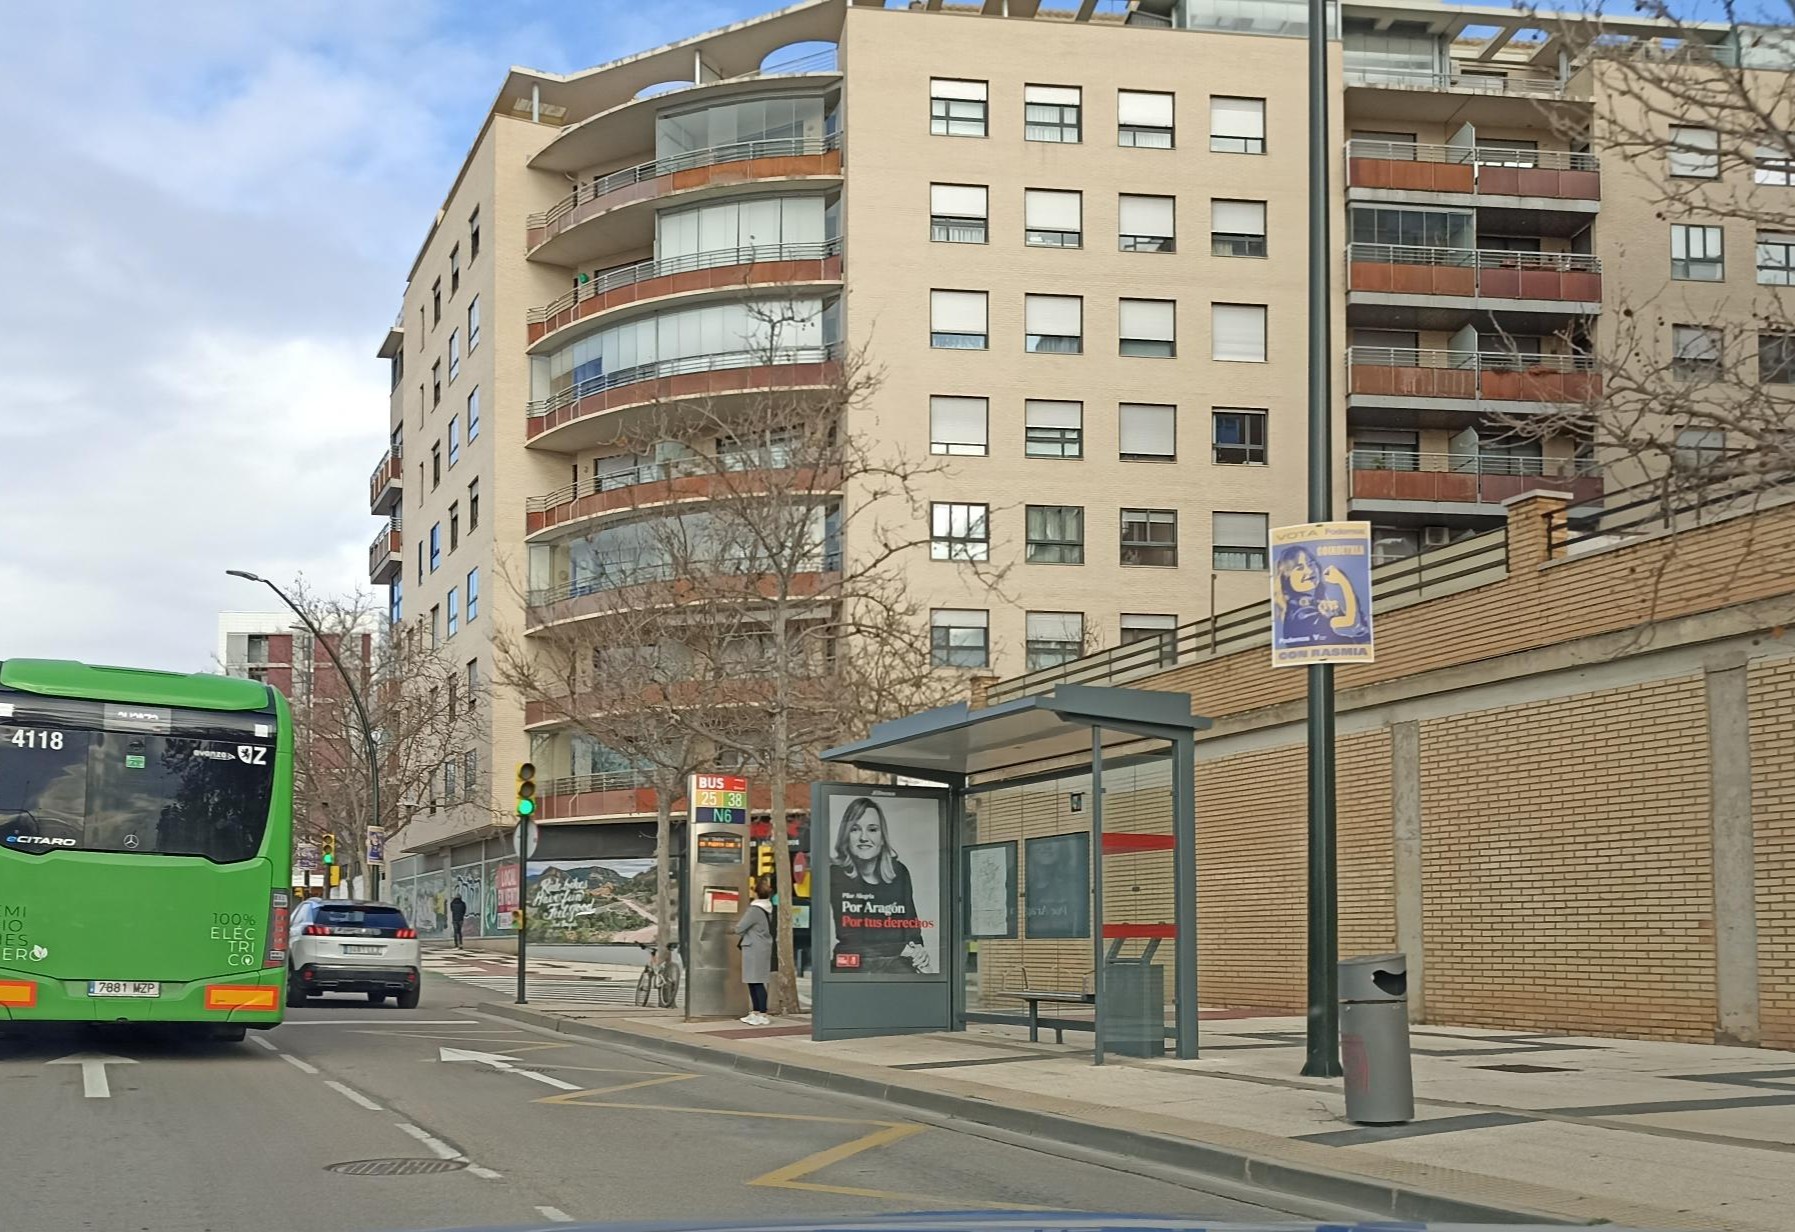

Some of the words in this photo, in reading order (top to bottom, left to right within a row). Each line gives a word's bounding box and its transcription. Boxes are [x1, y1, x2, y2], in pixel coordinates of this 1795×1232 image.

[1276, 530, 1318, 541] VOTA
[1279, 651, 1308, 660] CON
[1311, 648, 1368, 658] RASMIA
[11, 729, 64, 750] 4118
[698, 776, 725, 790] BUS
[701, 791, 717, 806] 25
[728, 792, 743, 807] 38
[713, 808, 732, 823] N6
[6, 835, 77, 846] eCITARO
[0, 905, 26, 918] MI
[842, 901, 863, 913] Por
[863, 902, 905, 916] Aragón
[212, 912, 256, 926] 100%
[842, 915, 863, 927] Por
[864, 917, 882, 928] tus
[884, 917, 934, 929] derechos
[210, 926, 256, 940] ELÉC
[228, 940, 255, 953] TRI
[228, 953, 254, 966] CO
[99, 982, 127, 993] 7881
[133, 983, 155, 993] MZP
